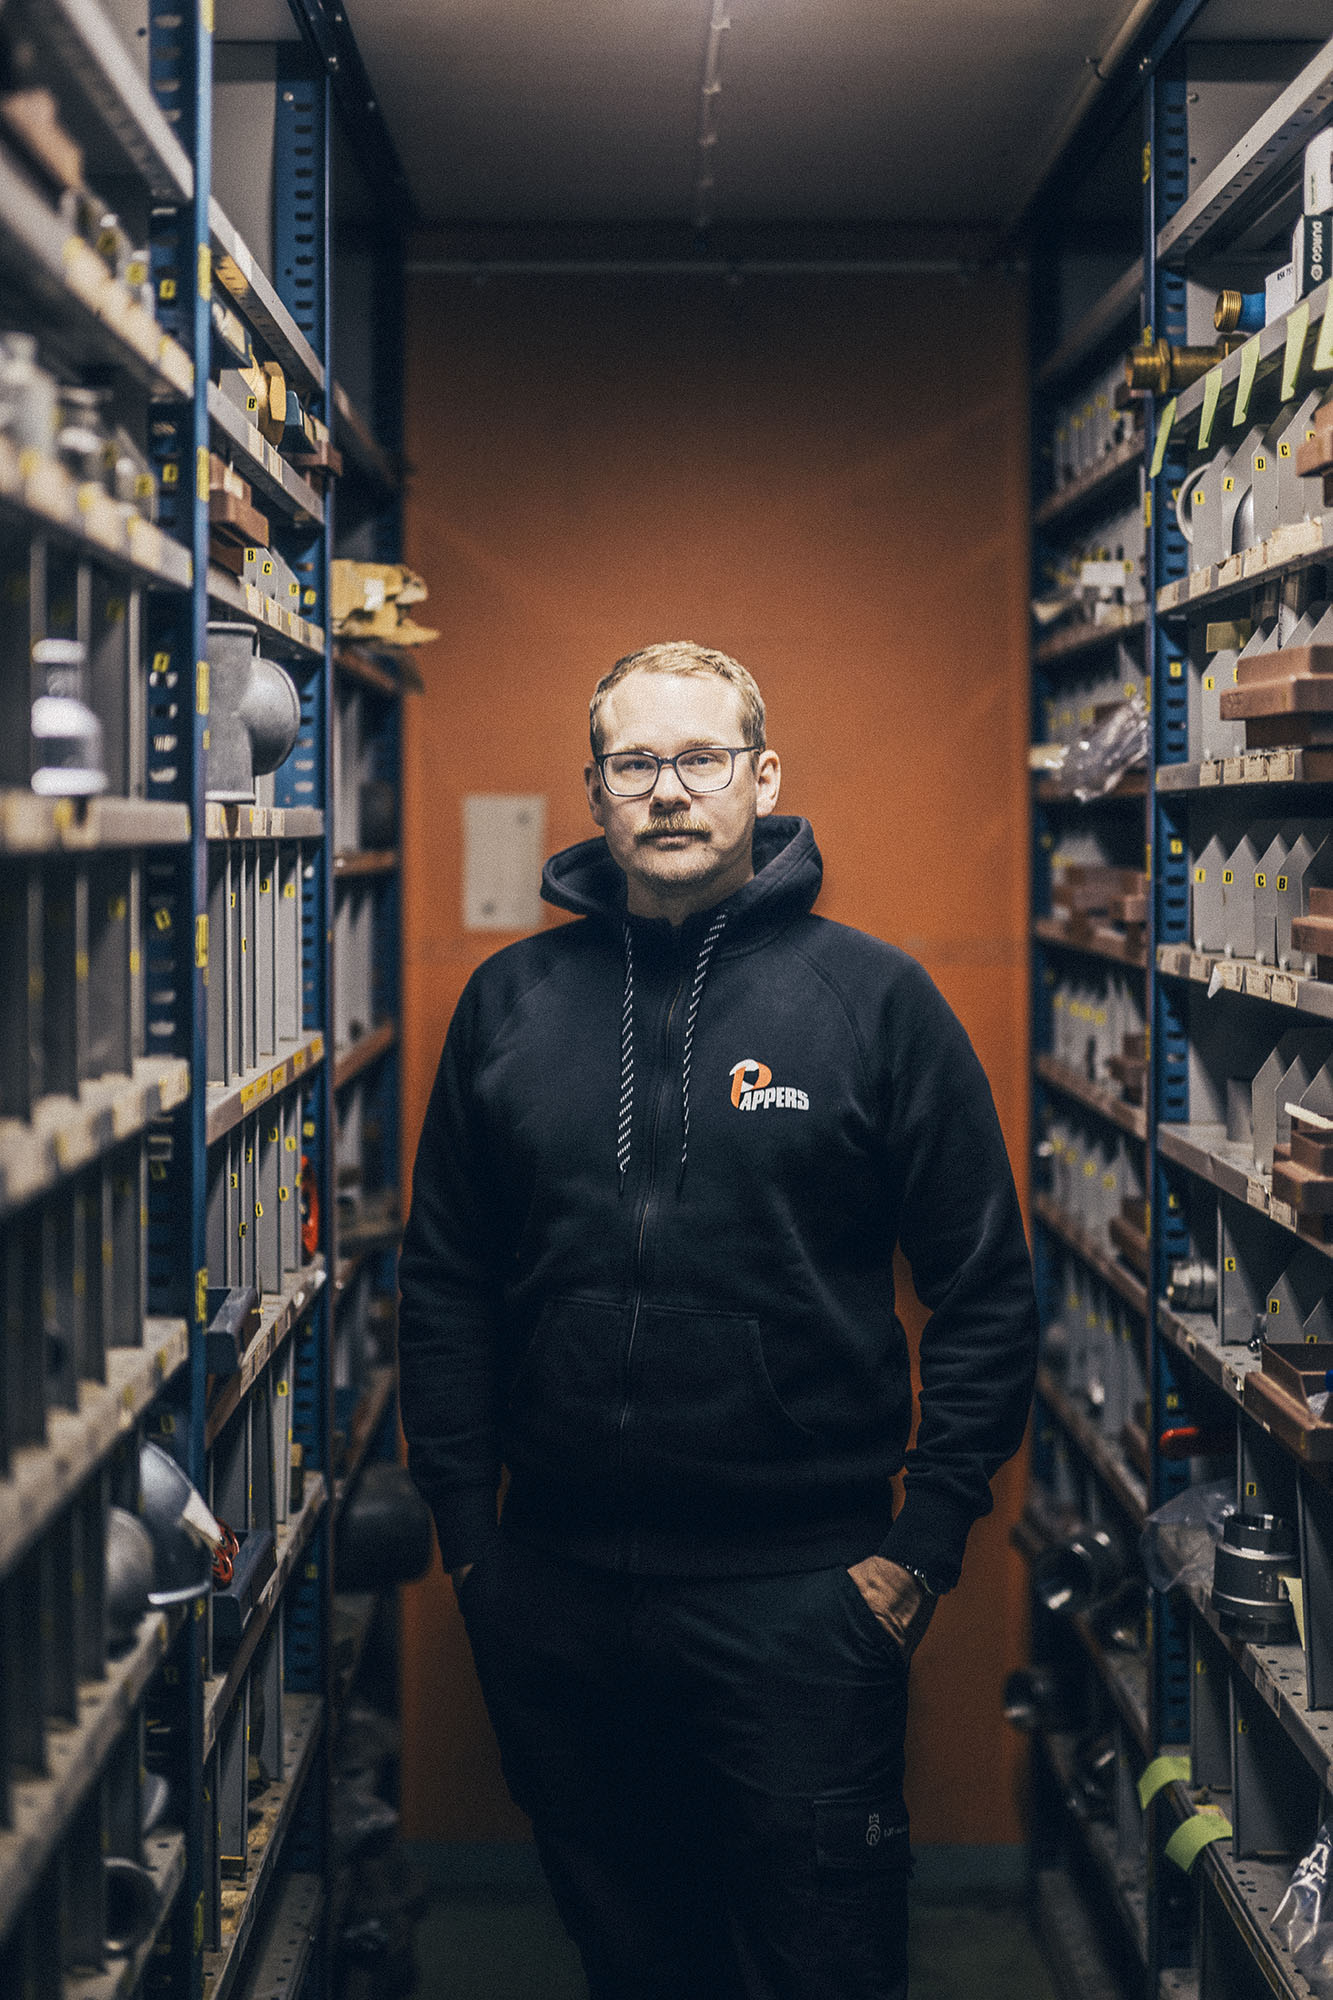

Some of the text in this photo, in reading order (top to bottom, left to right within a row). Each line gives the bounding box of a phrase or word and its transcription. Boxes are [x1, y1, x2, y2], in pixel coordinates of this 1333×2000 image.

[1311, 220, 1323, 263] DURGO
[248, 398, 255, 409] B
[1281, 445, 1288, 456] C
[1257, 458, 1264, 469] D
[247, 550, 254, 561] B
[263, 563, 271, 574] C
[1225, 872, 1232, 883] D
[1257, 875, 1265, 887] C
[1278, 878, 1286, 889] B
[729, 1059, 810, 1111] PAPPERS
[1227, 1258, 1234, 1270] C
[1270, 1301, 1278, 1313] B
